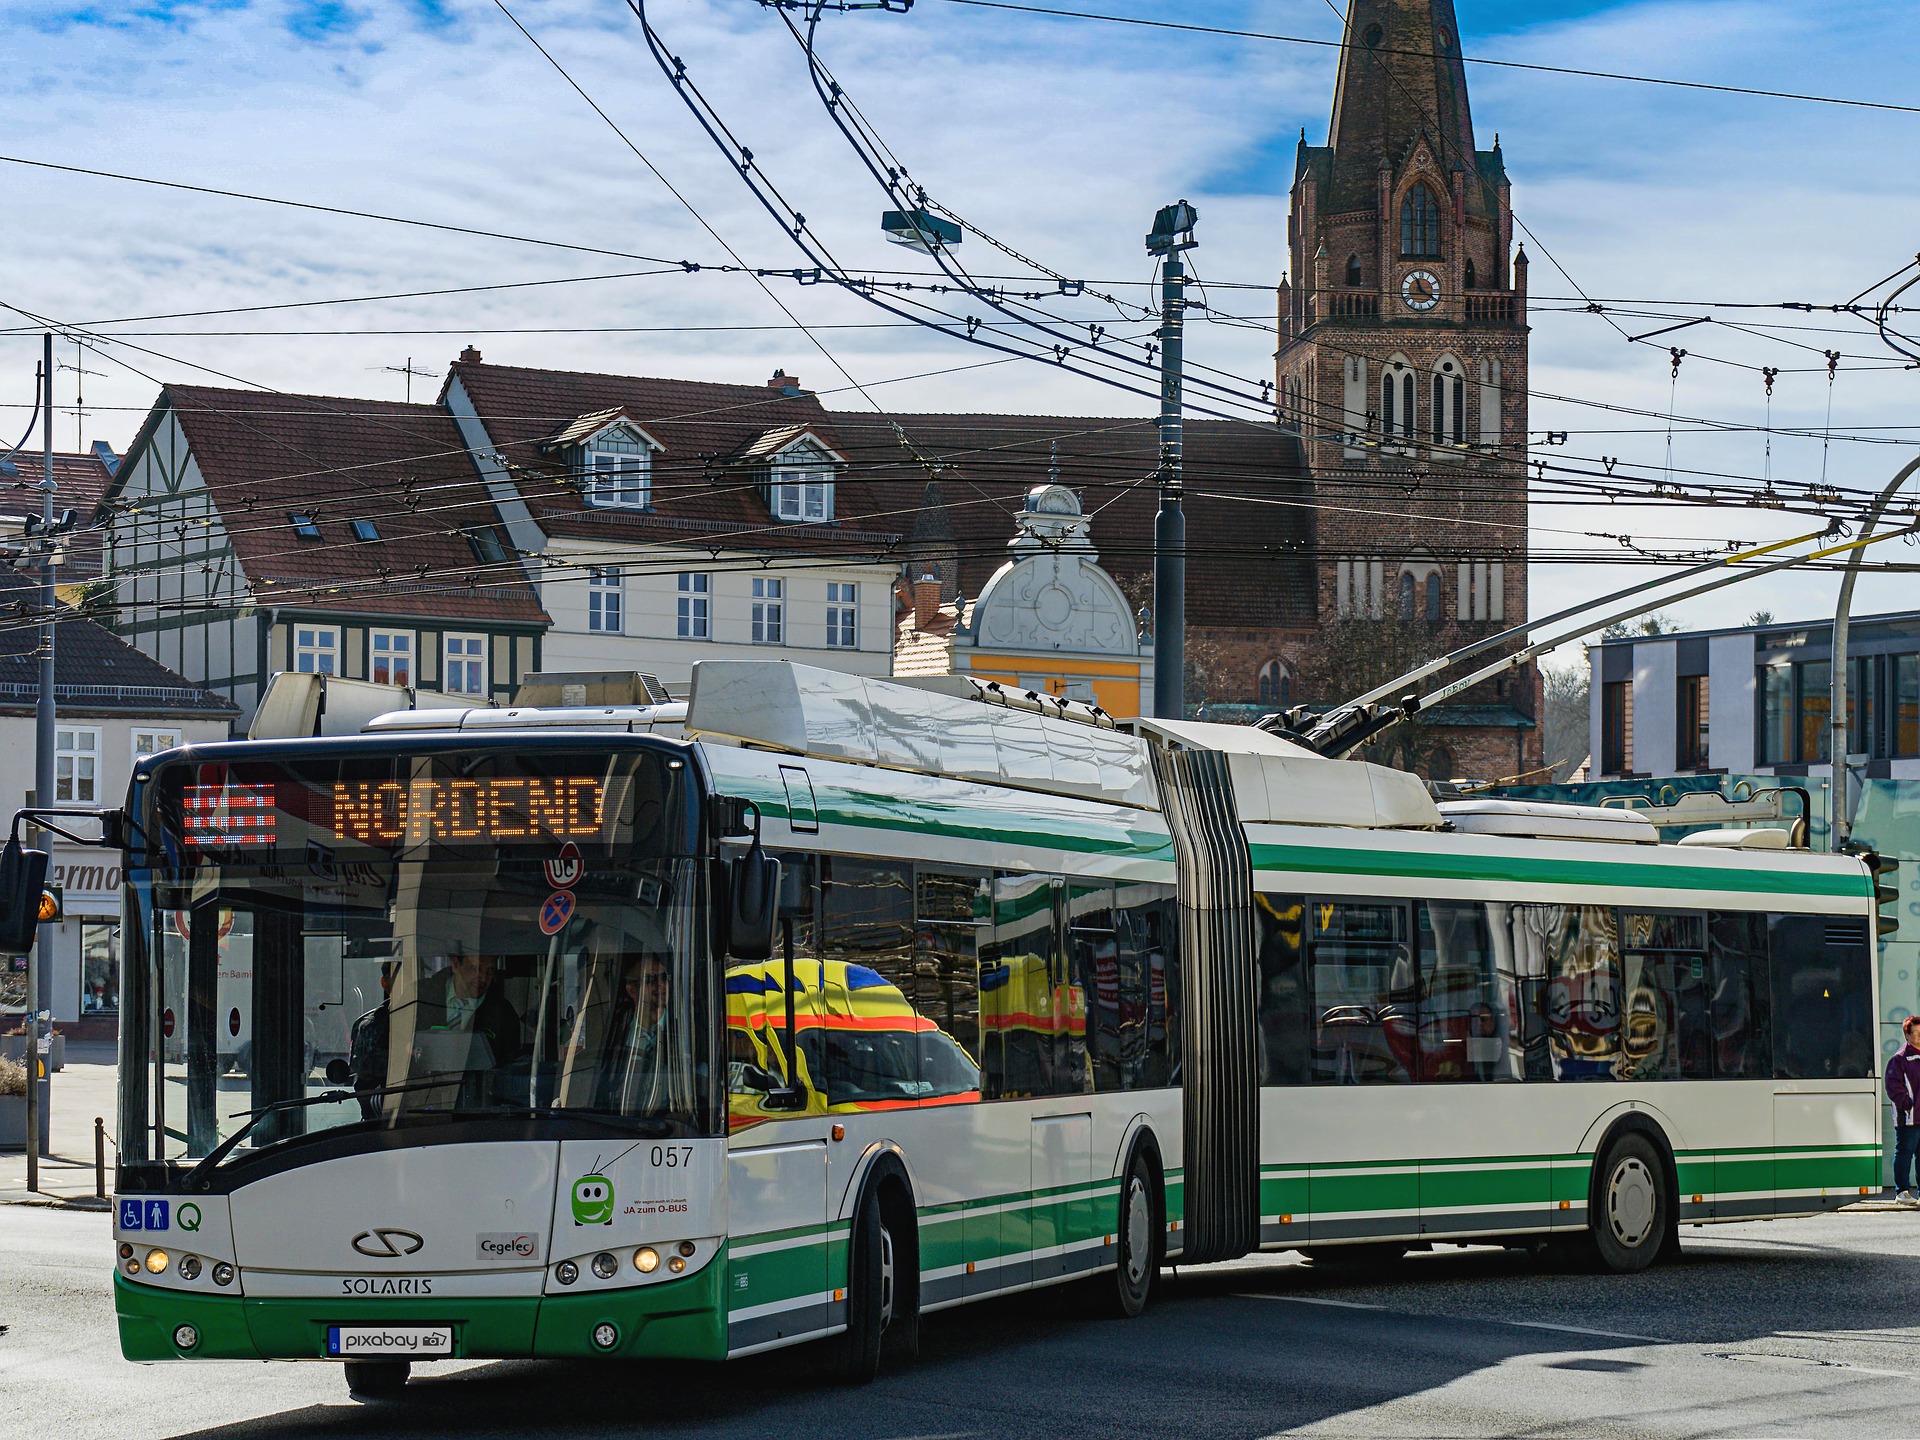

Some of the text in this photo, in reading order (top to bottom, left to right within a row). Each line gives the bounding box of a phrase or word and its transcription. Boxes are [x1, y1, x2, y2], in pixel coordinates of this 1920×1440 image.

[334, 778, 603, 839] NORDEND
[650, 1145, 694, 1168] 057
[624, 1204, 687, 1214] JA zum O-BUS
[480, 1239, 531, 1255] Cegelec
[341, 1278, 433, 1295] SOLARIS
[345, 1331, 418, 1351] pixabay
